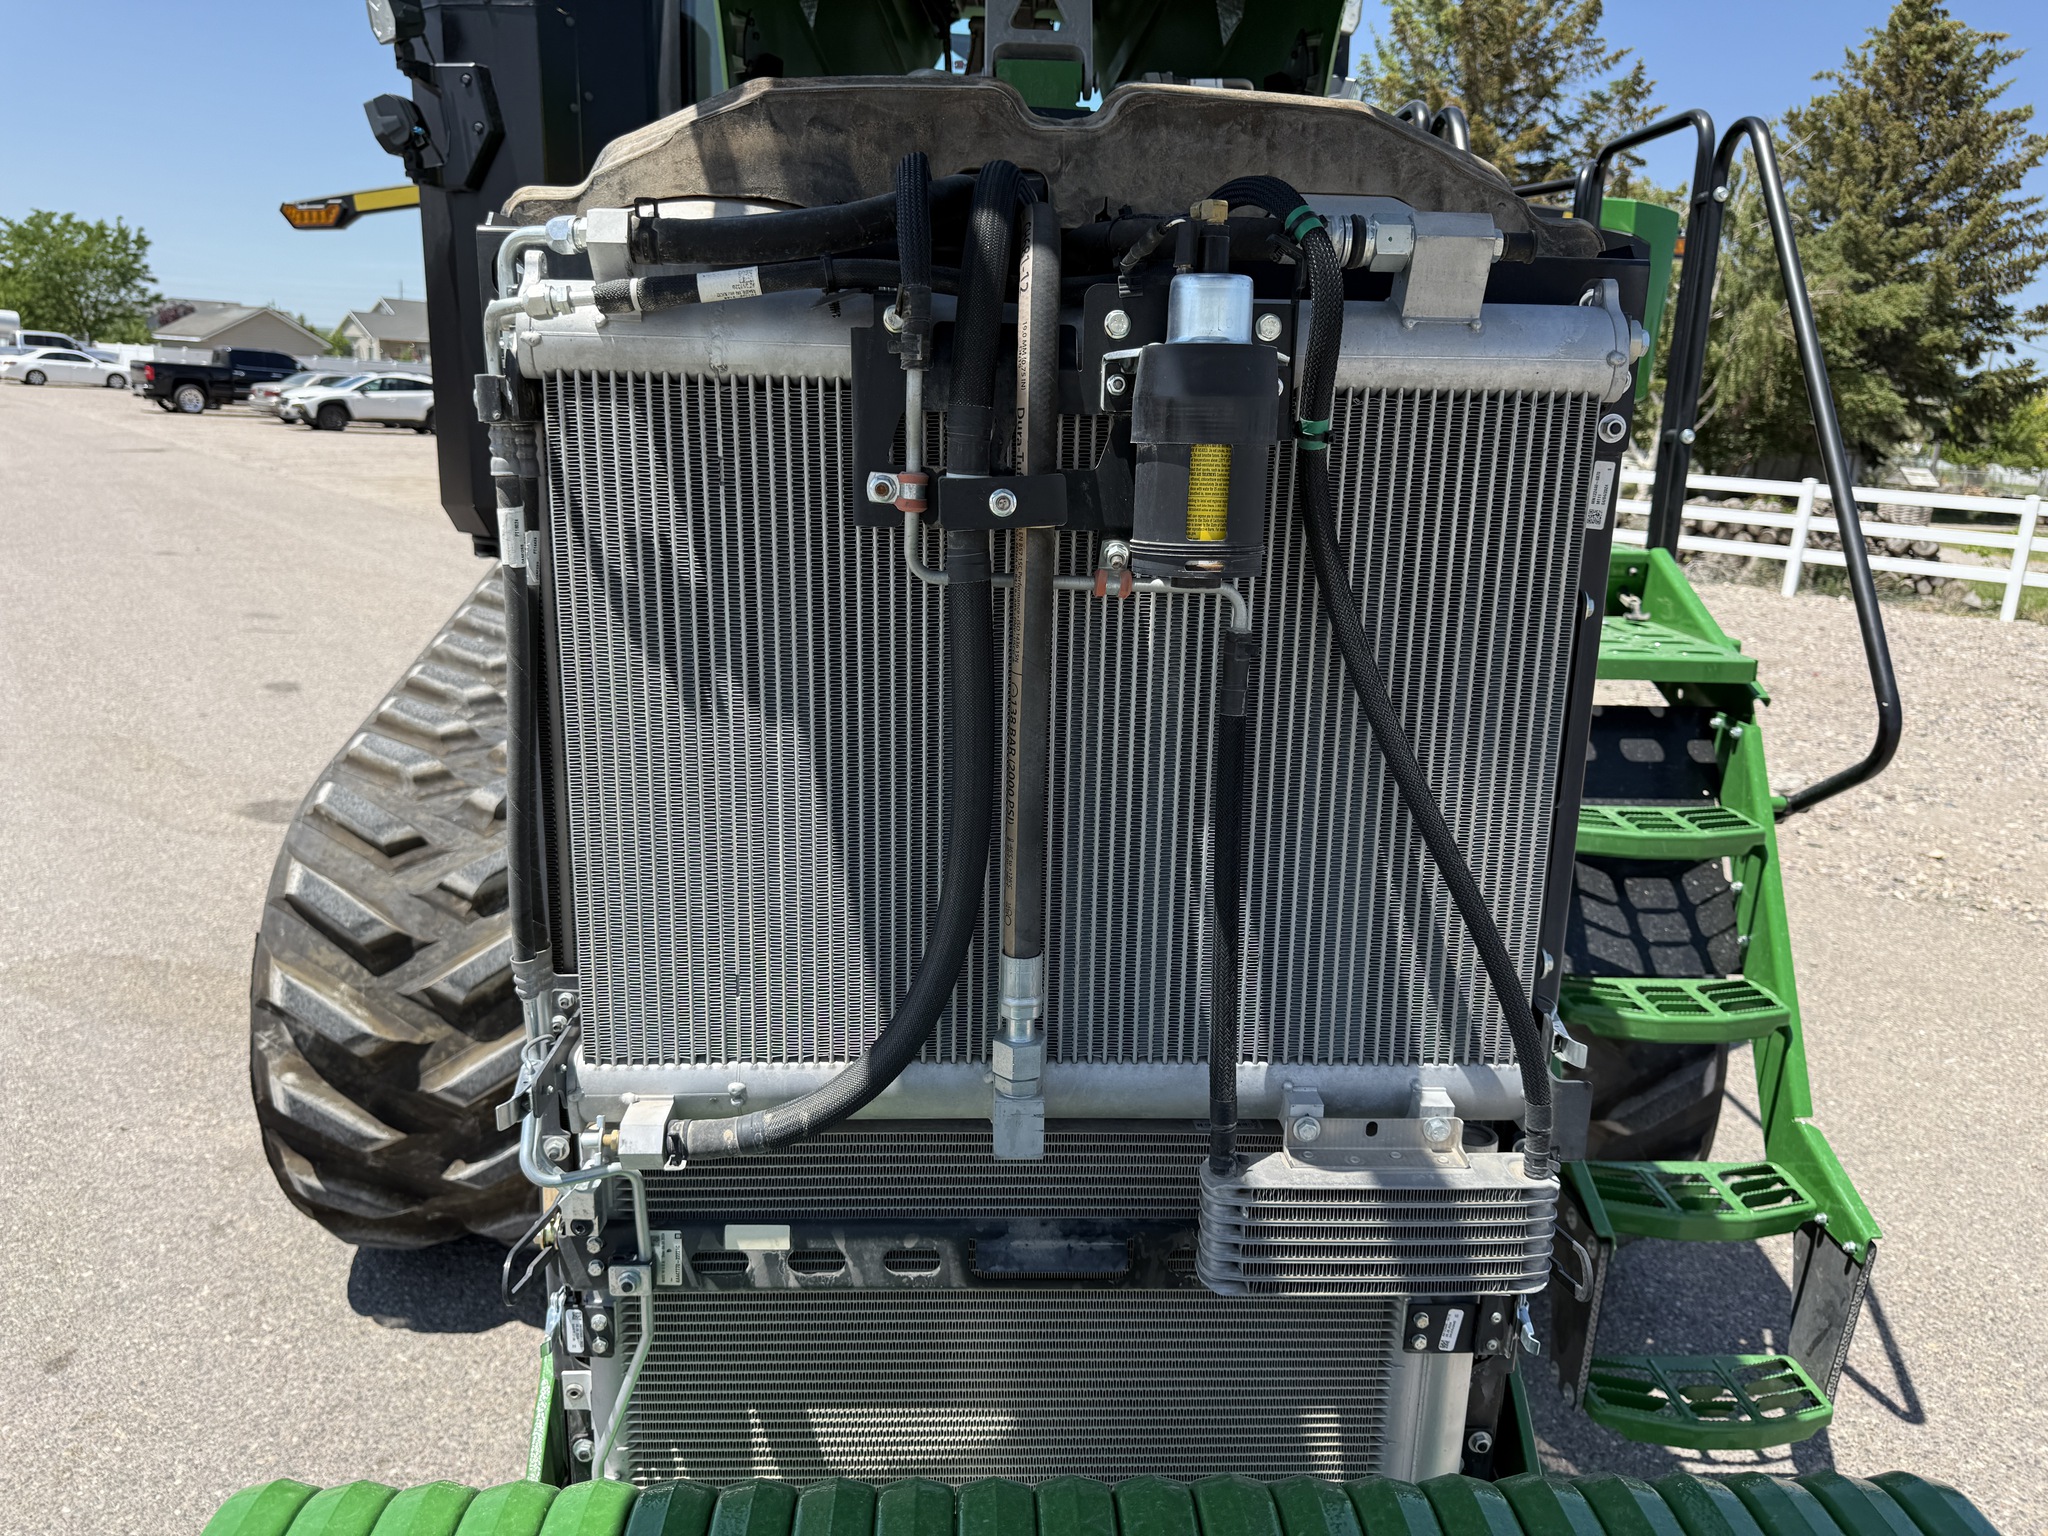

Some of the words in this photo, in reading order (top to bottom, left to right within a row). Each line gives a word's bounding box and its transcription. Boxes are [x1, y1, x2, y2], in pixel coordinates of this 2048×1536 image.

[1021, 339, 1028, 356] MM
[1009, 727, 1017, 757] BAR
[1008, 758, 1016, 797] (2000
[1007, 799, 1015, 825] PSI)
